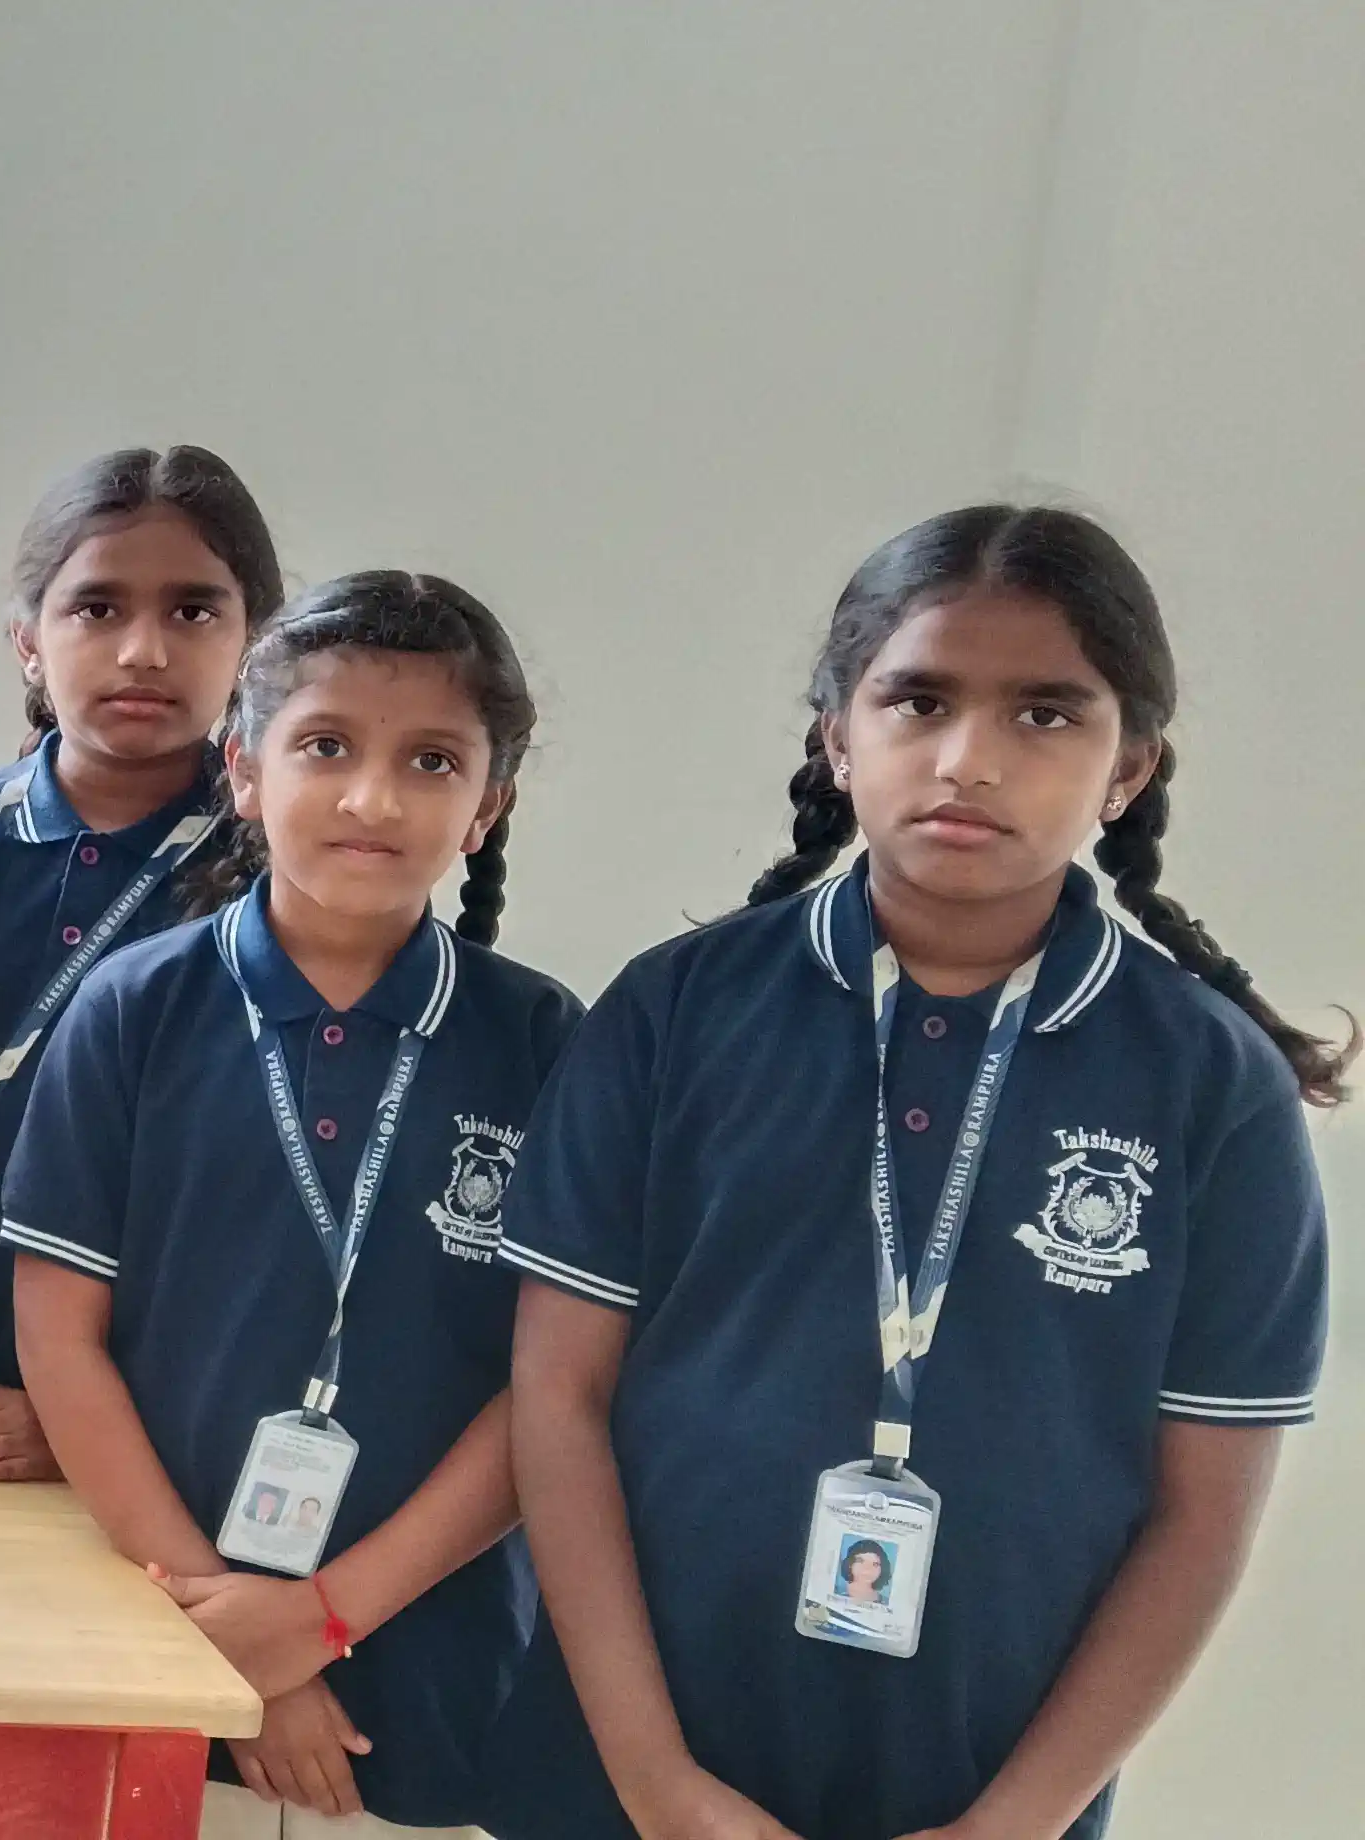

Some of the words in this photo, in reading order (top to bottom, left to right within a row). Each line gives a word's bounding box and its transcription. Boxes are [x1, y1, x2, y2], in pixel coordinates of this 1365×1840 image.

[37, 873, 154, 1013] TAKSHASHILA@RAMPURA
[264, 1050, 334, 1234] TAKSHASHILA@RAMPURA
[351, 1055, 415, 1233] TAKSHASHILA@RAMPURA
[452, 1112, 527, 1151] Takshashil
[928, 1053, 1003, 1261] TAKSHASHILA@RAMPURA
[1052, 1126, 1160, 1174] Takshashila
[442, 1235, 493, 1264] Rampura
[1044, 1262, 1113, 1294] Rampura
